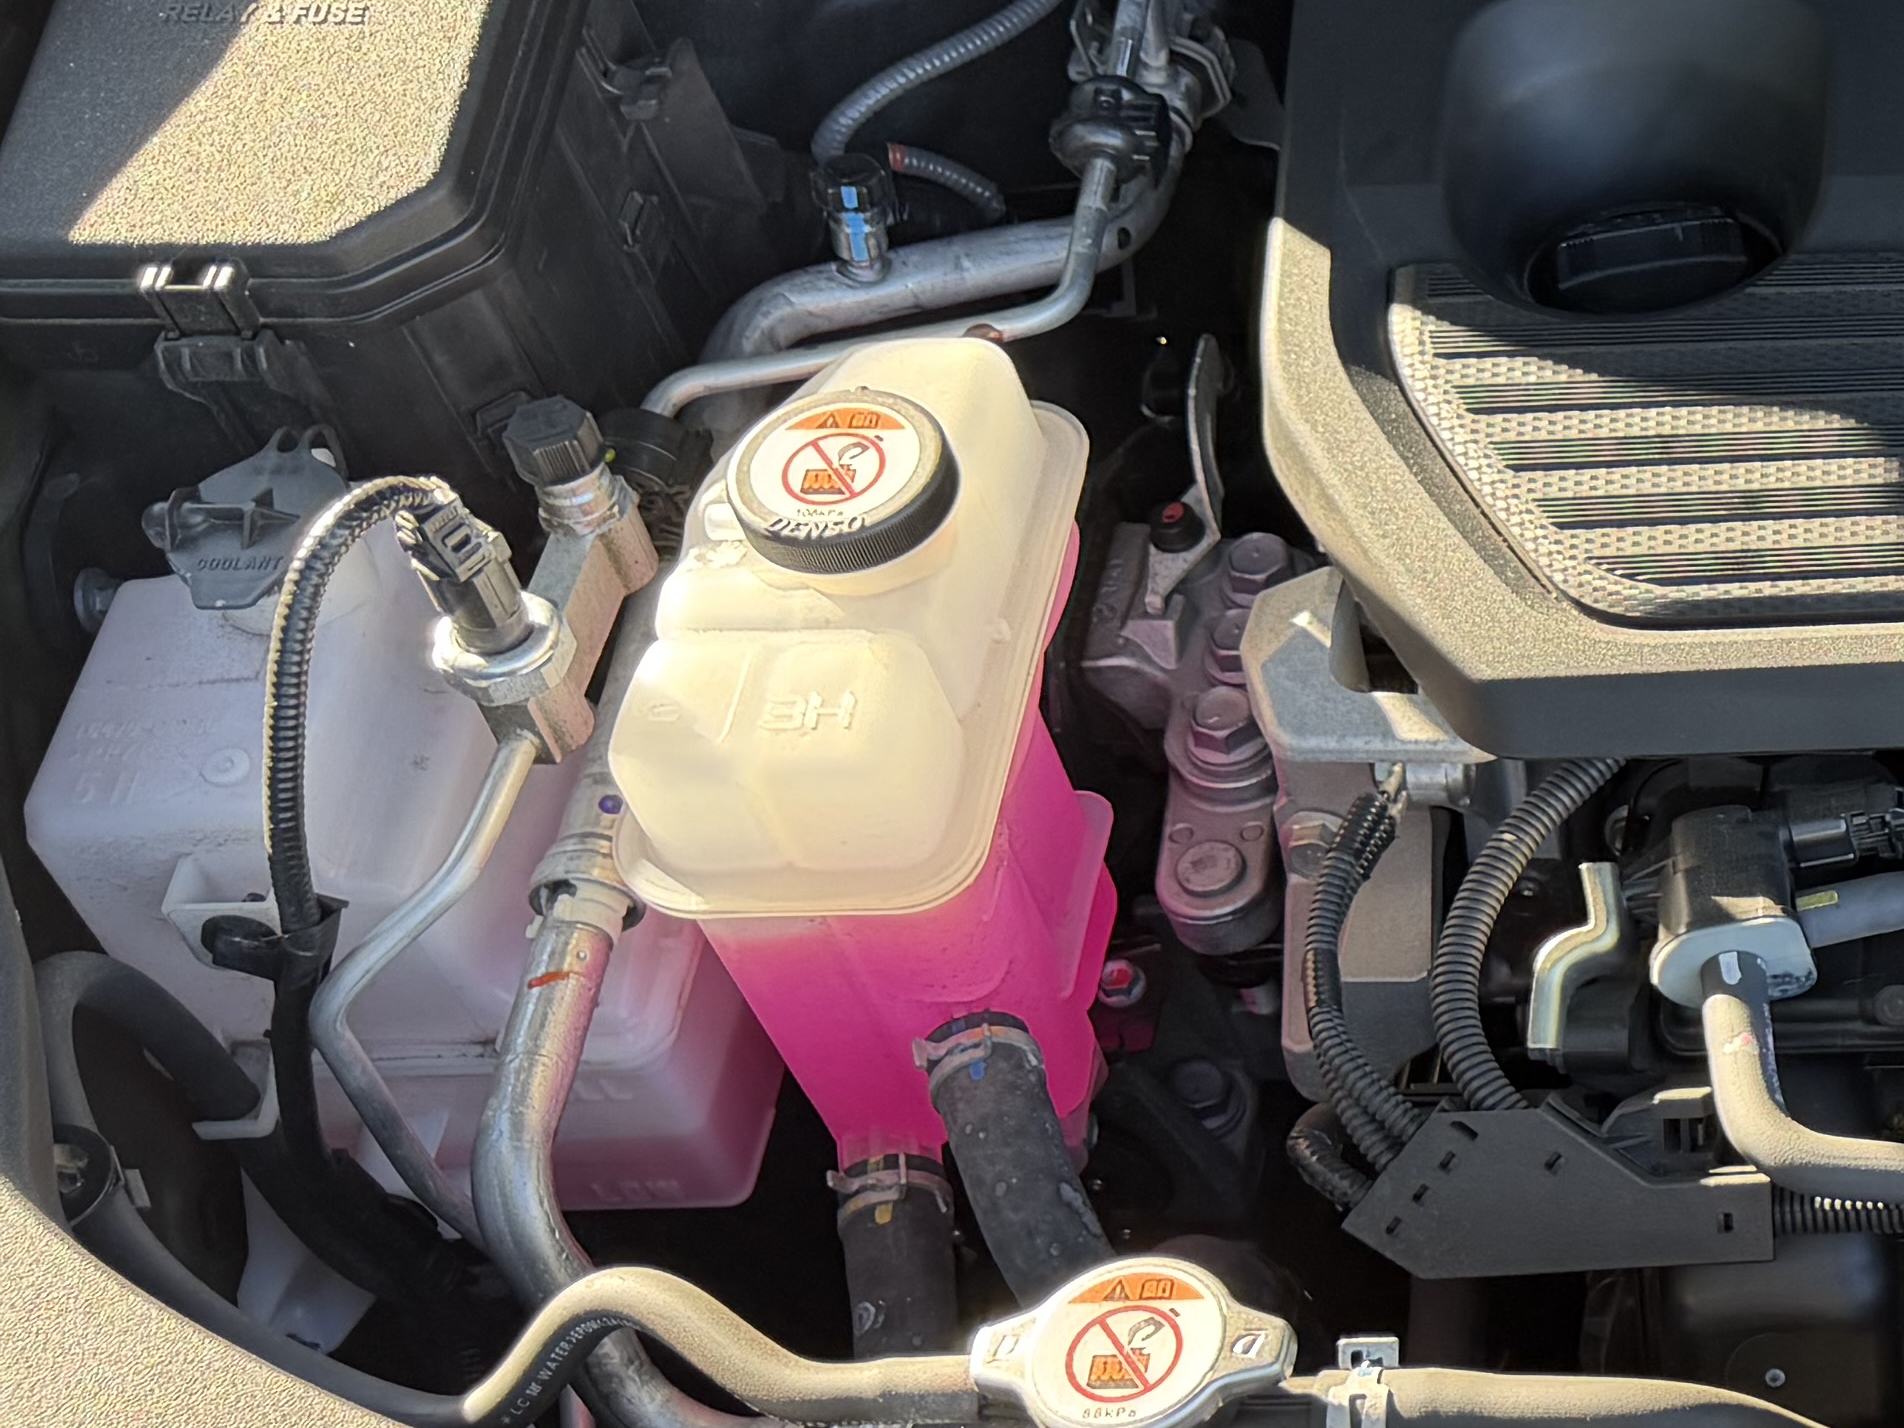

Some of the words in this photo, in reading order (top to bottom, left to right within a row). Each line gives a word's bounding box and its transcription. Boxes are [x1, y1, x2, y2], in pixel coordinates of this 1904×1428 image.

[293, 2, 373, 26] FUSE
[766, 516, 866, 540] DENSO
[197, 556, 284, 571] COOLANT
